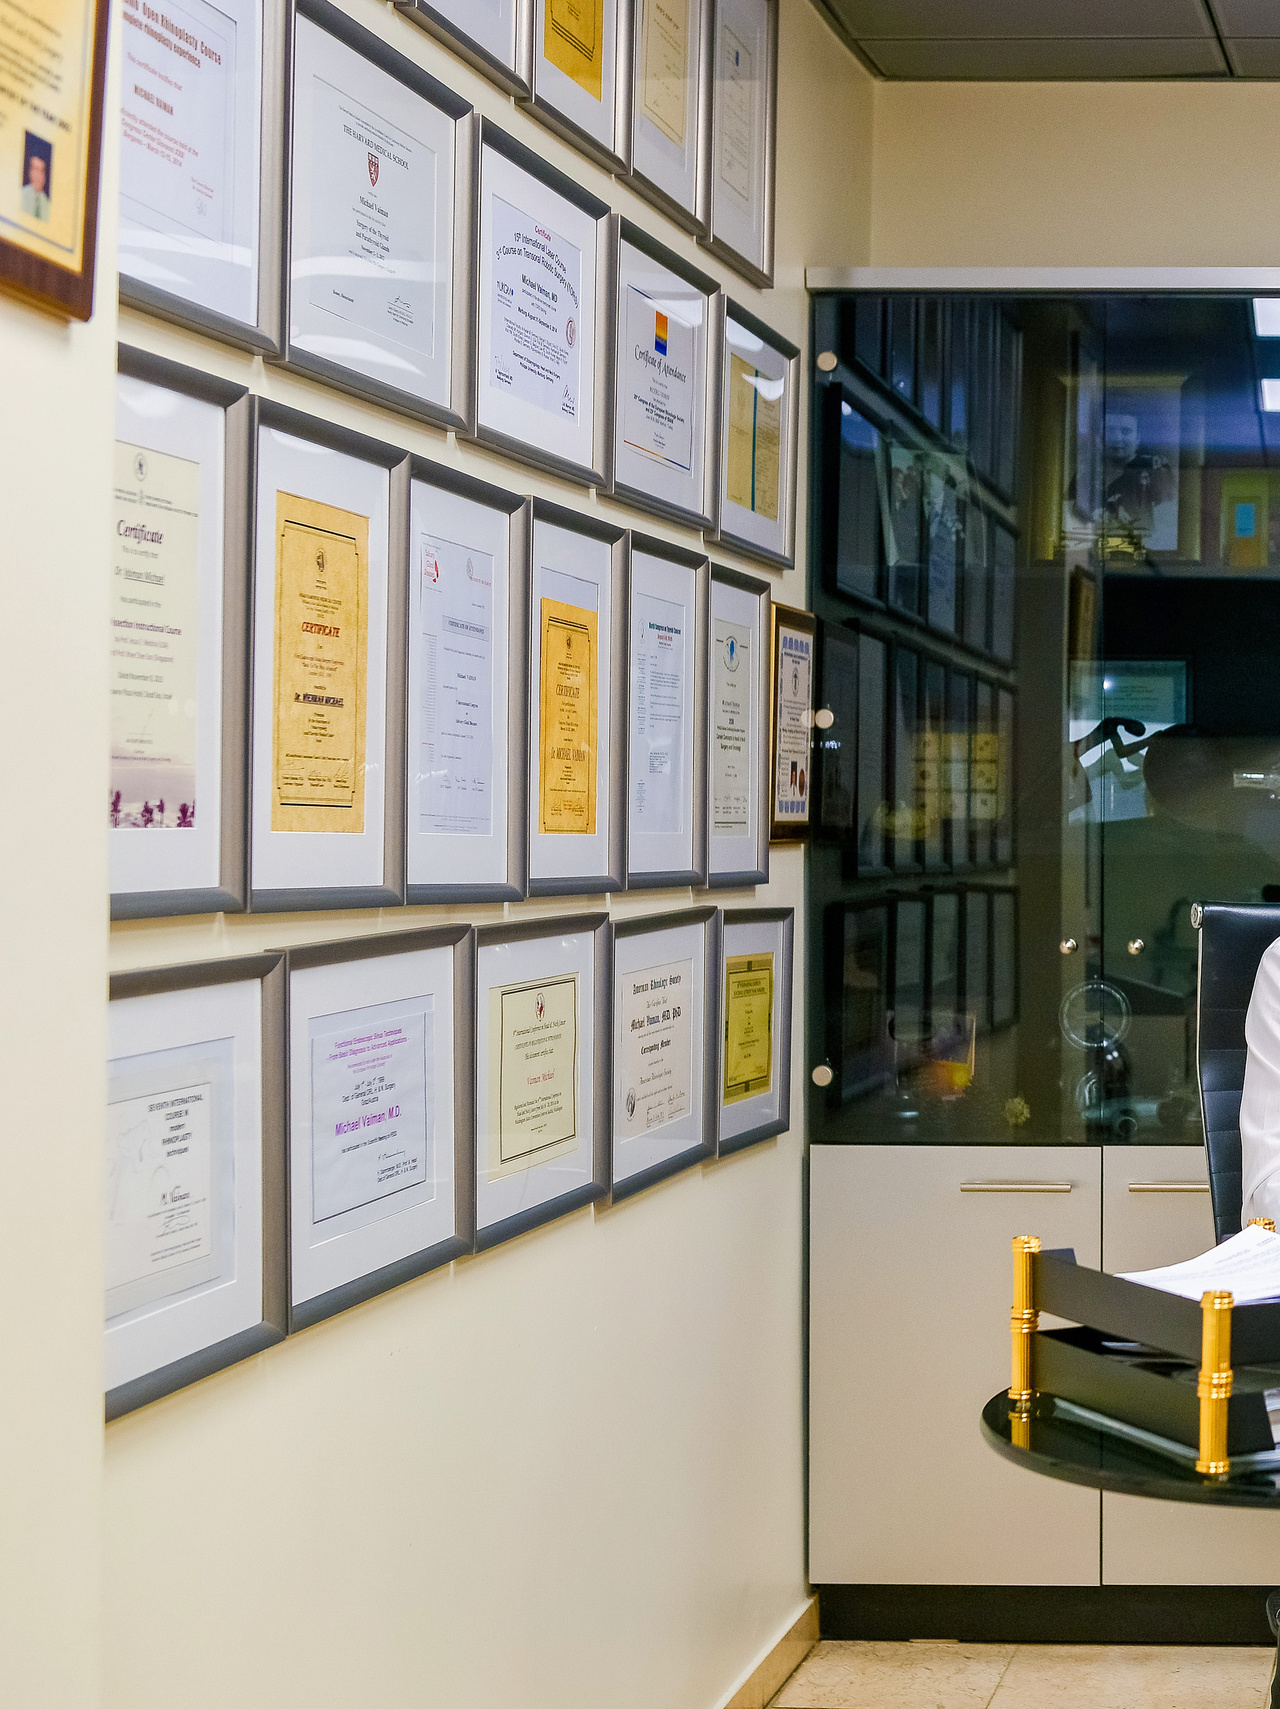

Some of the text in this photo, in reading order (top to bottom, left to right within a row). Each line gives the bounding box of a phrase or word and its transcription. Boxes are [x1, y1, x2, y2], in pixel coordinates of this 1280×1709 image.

[161, 14, 198, 50] Rhinoplasty
[201, 41, 221, 65] Course
[117, 519, 164, 545] Certificate
[301, 621, 341, 638] CERTIFICATE
[335, 1105, 402, 1137] Michael Vaiman, M.D.
